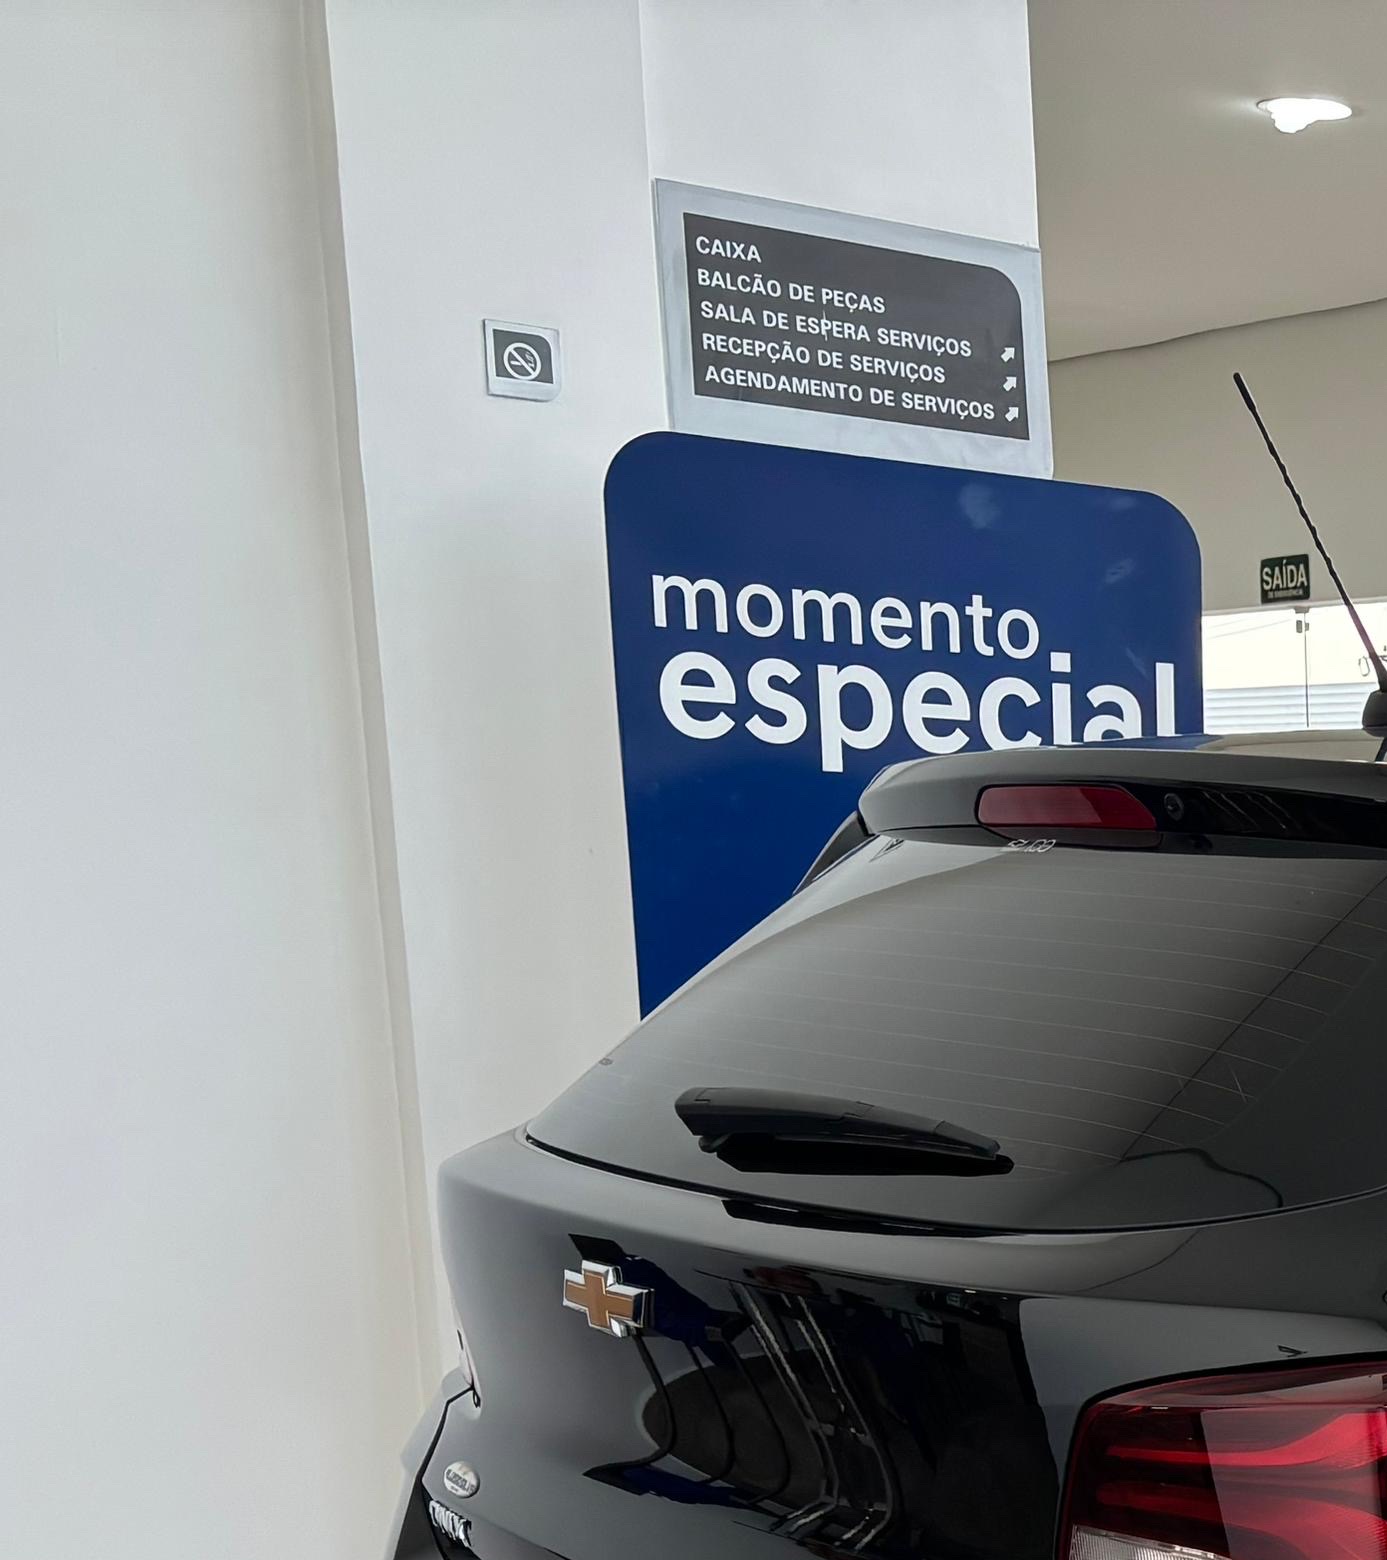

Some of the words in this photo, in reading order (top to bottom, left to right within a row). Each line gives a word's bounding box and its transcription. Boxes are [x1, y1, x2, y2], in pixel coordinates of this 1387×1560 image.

[696, 236, 762, 263] CAIXA
[697, 268, 782, 298] BALCÃO
[788, 283, 815, 303] DE
[821, 288, 886, 313] PEÇAS
[701, 301, 756, 325] SALA
[763, 310, 789, 331] DE
[796, 315, 870, 342] ESPERA
[877, 327, 972, 358] SERVIÇOS
[702, 333, 810, 364] RECEPÇÃO
[817, 349, 843, 369] DE
[850, 354, 946, 384] SERVIÇOS
[705, 366, 863, 402] AGENDAMENTO
[870, 387, 895, 407] DE
[901, 392, 995, 420] SERVIÇOS
[1262, 560, 1307, 590] SAÍDA
[652, 574, 1040, 660] momento
[659, 651, 1175, 773] especial
